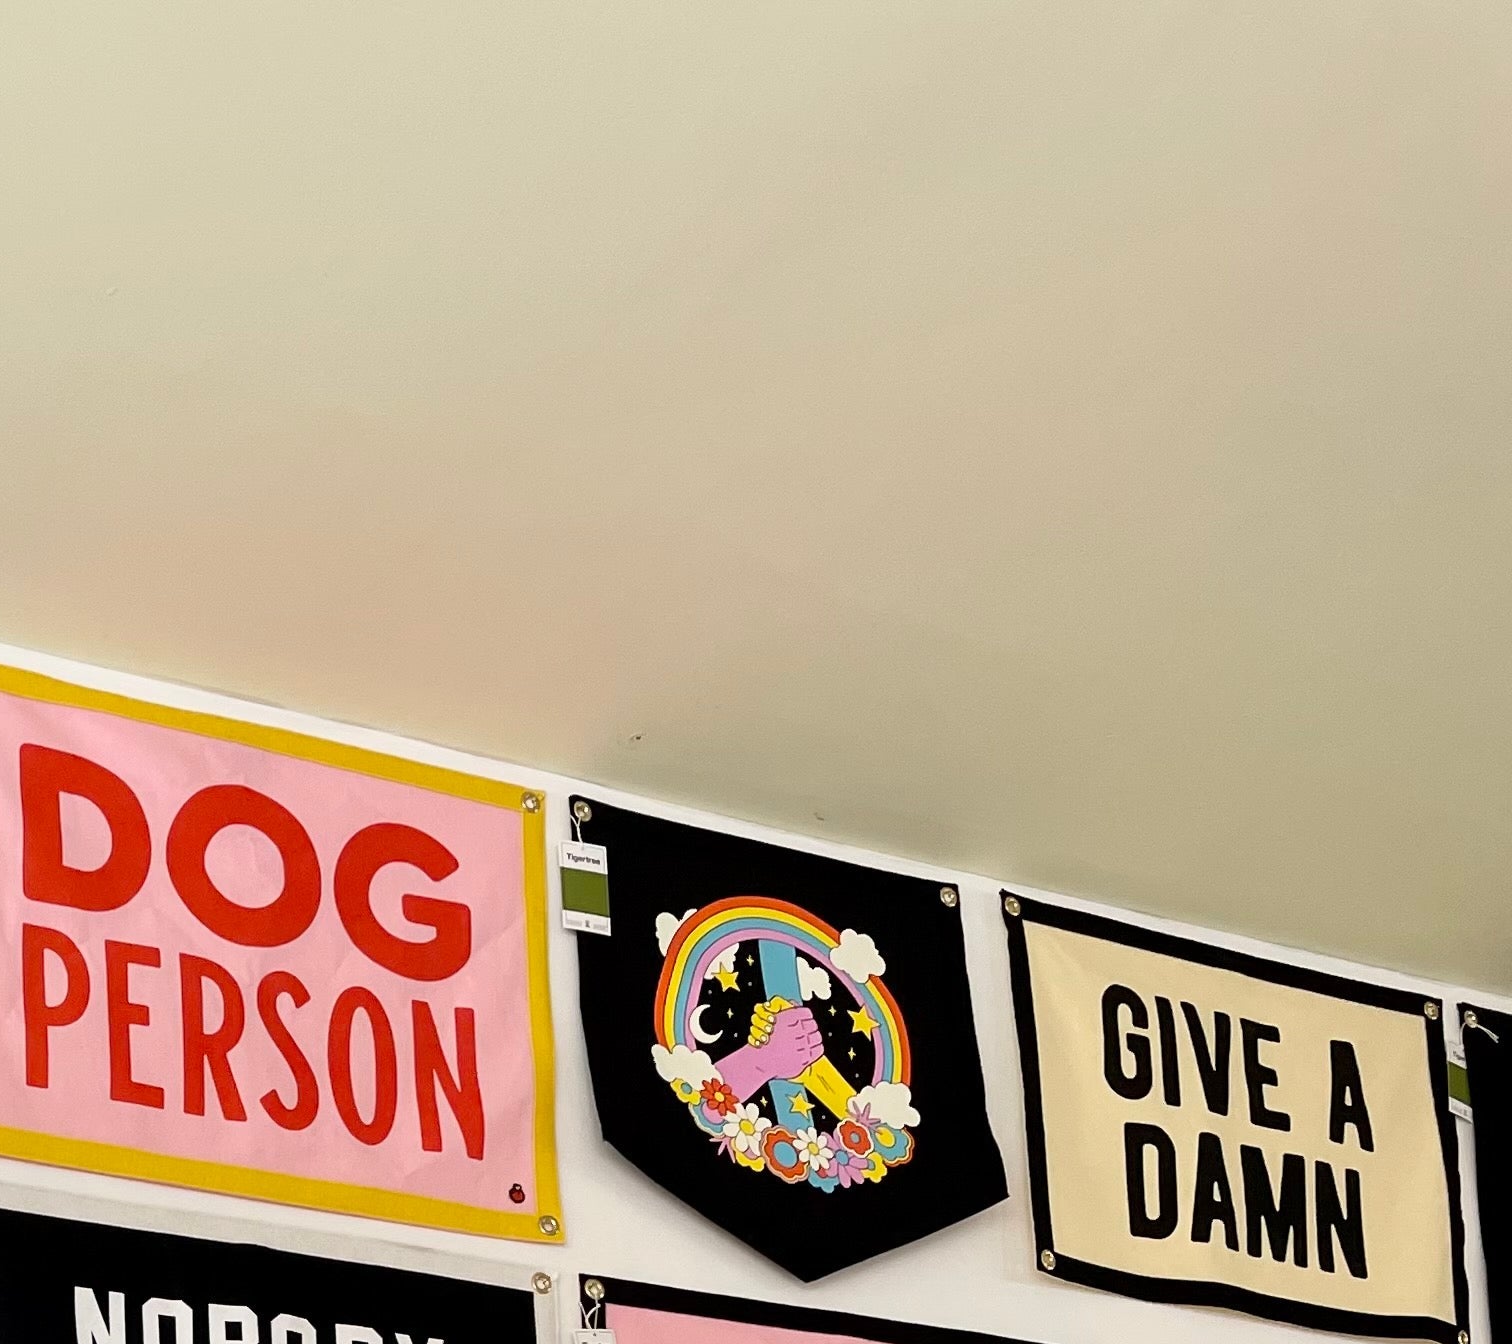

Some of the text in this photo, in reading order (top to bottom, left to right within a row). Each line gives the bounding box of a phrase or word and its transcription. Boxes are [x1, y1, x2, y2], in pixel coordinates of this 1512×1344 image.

[19, 743, 472, 982] DOG
[566, 852, 601, 866] Tigertree
[22, 923, 485, 1160] PERSON
[1101, 983, 1375, 1153] GIVE A
[1122, 1121, 1369, 1281] DAMN
